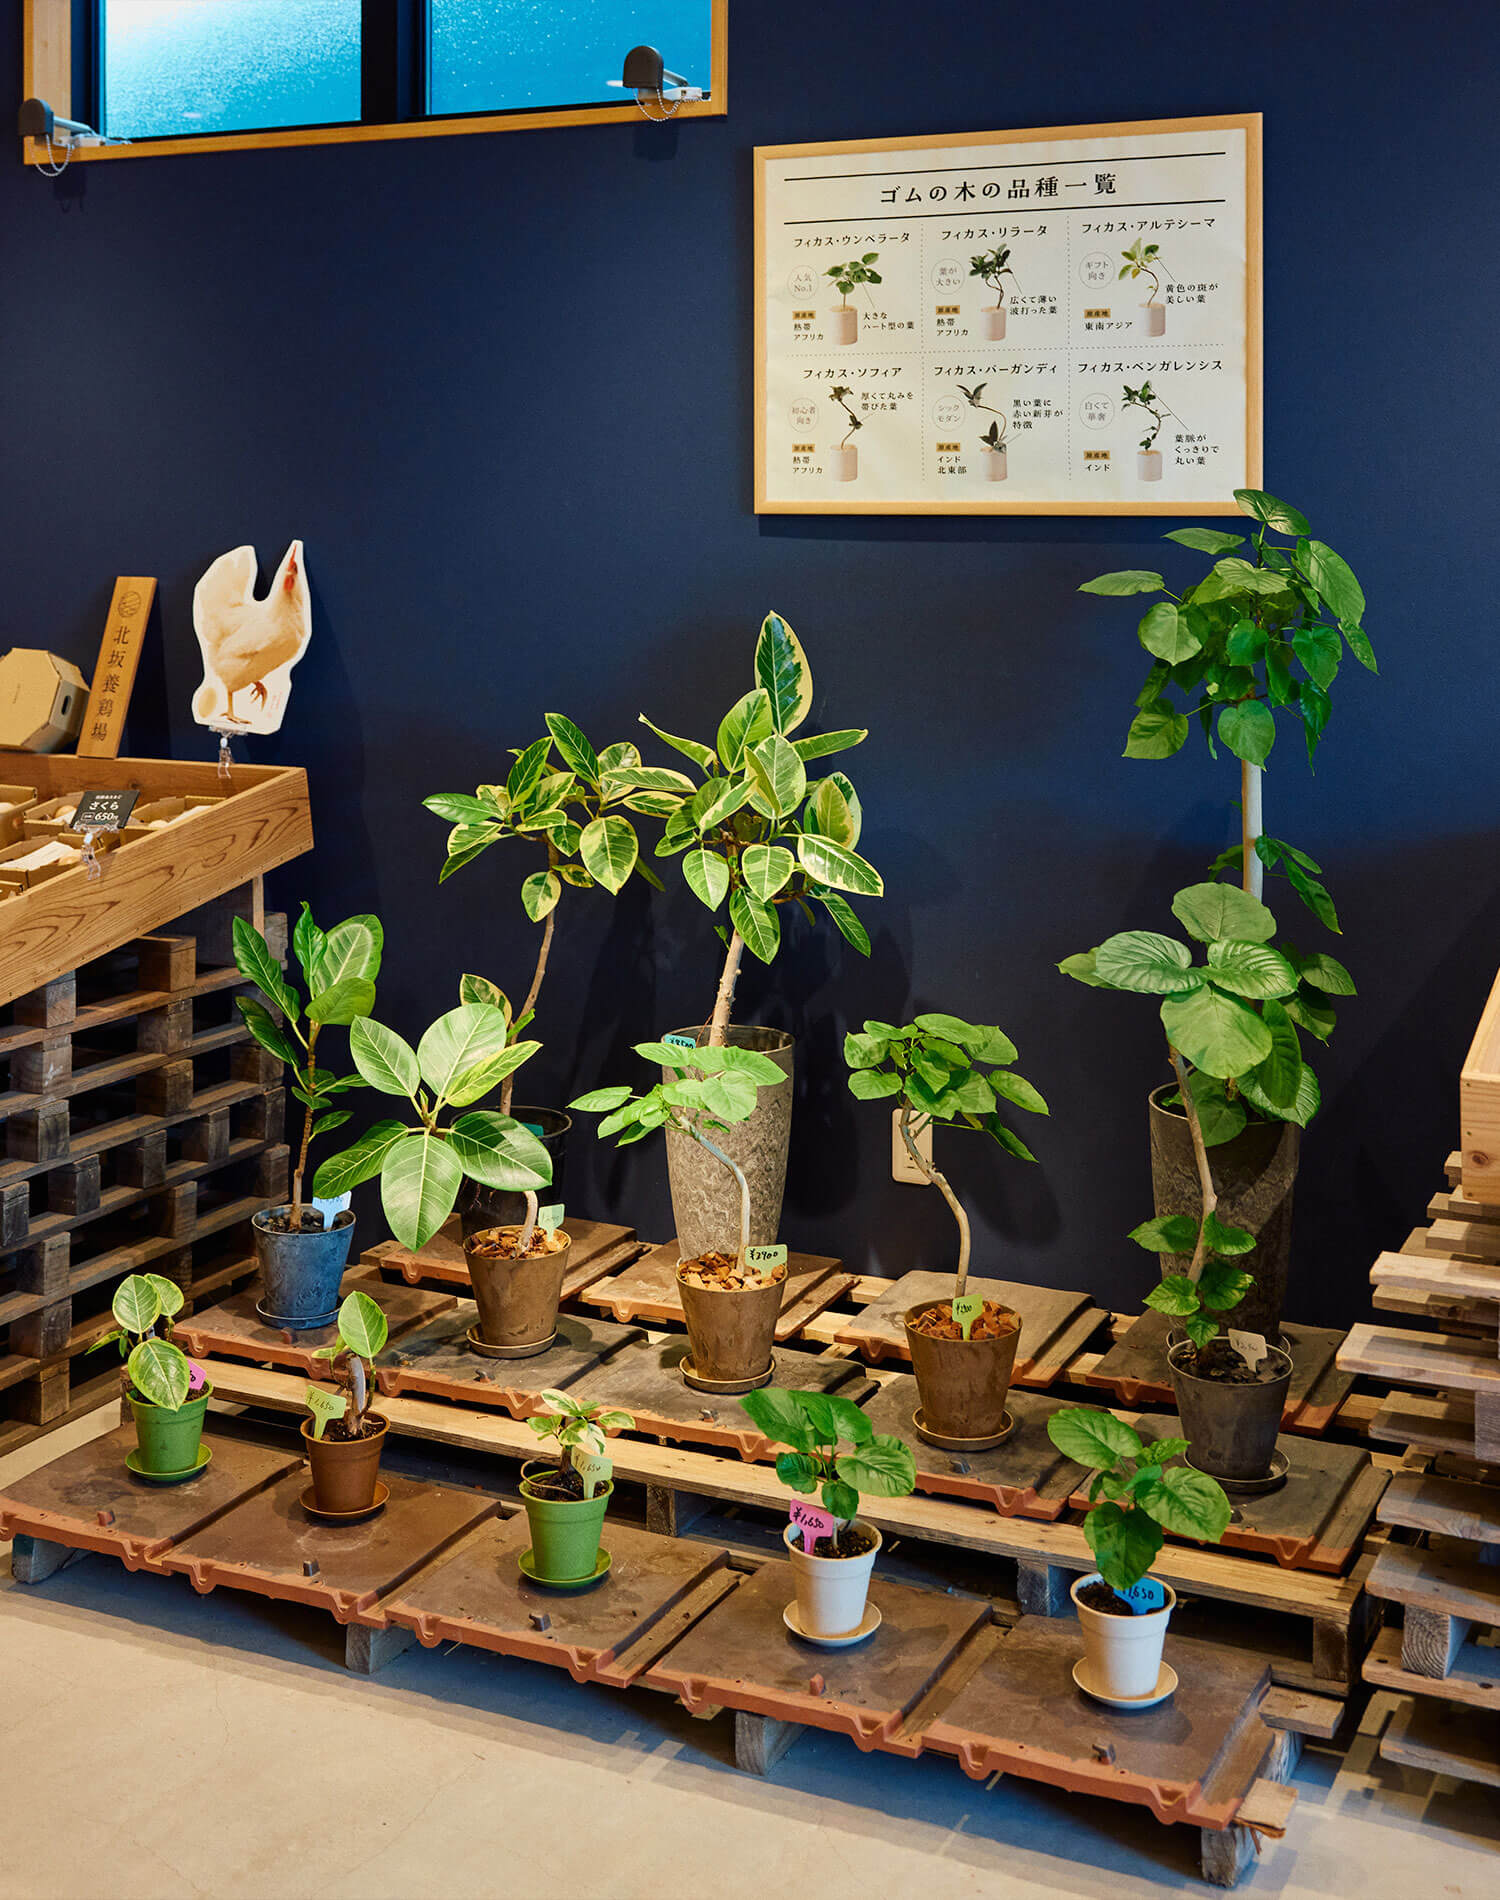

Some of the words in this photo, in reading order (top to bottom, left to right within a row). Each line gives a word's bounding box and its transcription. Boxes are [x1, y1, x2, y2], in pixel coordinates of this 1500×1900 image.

[880, 172, 1117, 204] ゴムの木の品種一覧
[1081, 218, 1216, 234] フィカス・アルテシーマ
[941, 225, 1047, 241] フィカス・リラータ
[863, 312, 888, 321] 大きな
[793, 333, 824, 341] アフリカ
[936, 329, 969, 337] アフリカ
[1078, 360, 1222, 374] フィカス・ベンガレンシス
[803, 367, 902, 380] フィカス・ソフィア
[937, 455, 961, 464] インド
[1085, 463, 1111, 473] インド
[88, 801, 119, 811] さくら
